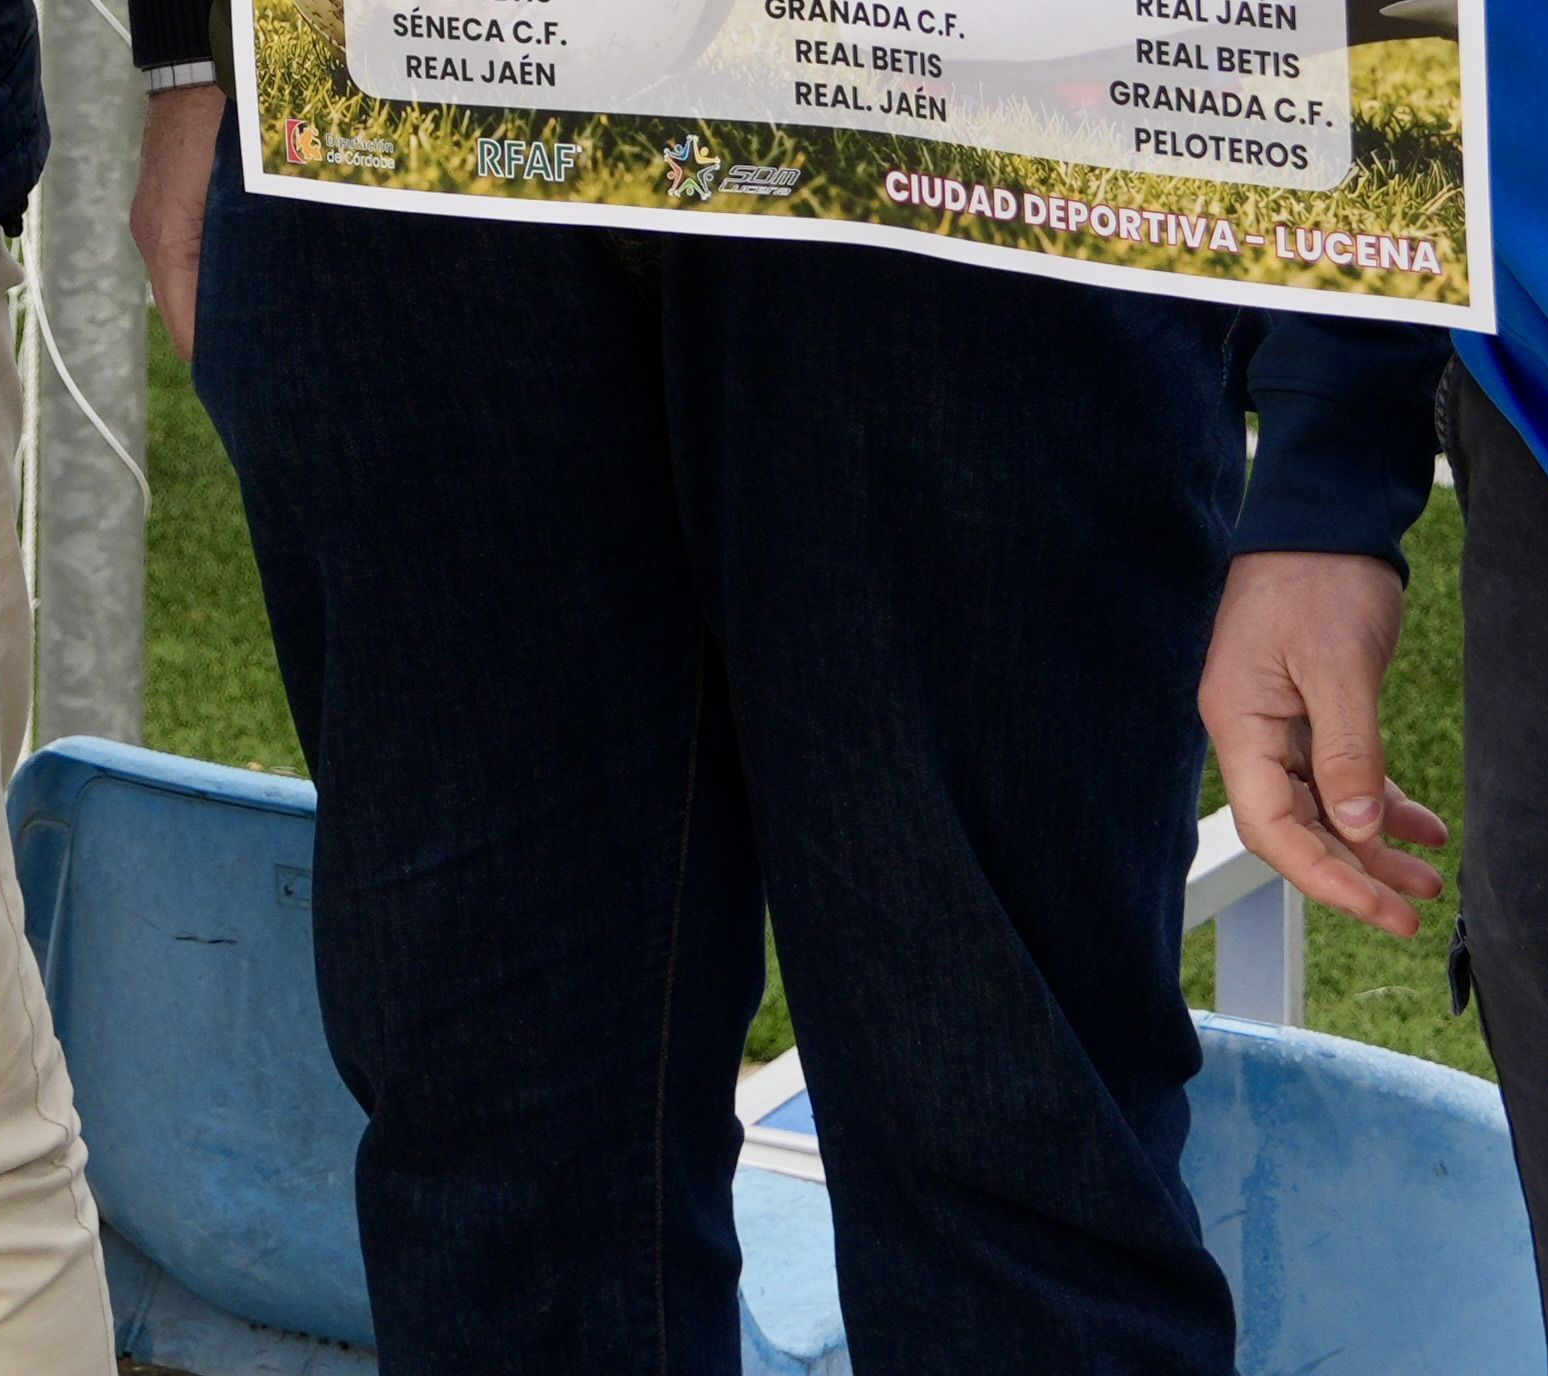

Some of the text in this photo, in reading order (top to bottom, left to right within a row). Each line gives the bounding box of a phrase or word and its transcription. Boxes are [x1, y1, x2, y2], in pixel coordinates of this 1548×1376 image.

[393, 8, 567, 46] SÉNECA C.F.
[917, 10, 965, 39] C.F.
[406, 54, 556, 86] REAL JAÉN
[795, 40, 942, 78] REAL BETIS
[1136, 39, 1299, 79] REAL BETIS
[795, 80, 947, 122] REAL. JAÉN
[1110, 80, 1332, 128] GRANADA C.F.
[344, 152, 396, 170] Córdoba
[477, 138, 582, 182] RFAF
[1135, 127, 1308, 170] PELOTEROS
[885, 170, 1442, 275] CIUDAD DEPORTIVA LUCENA
